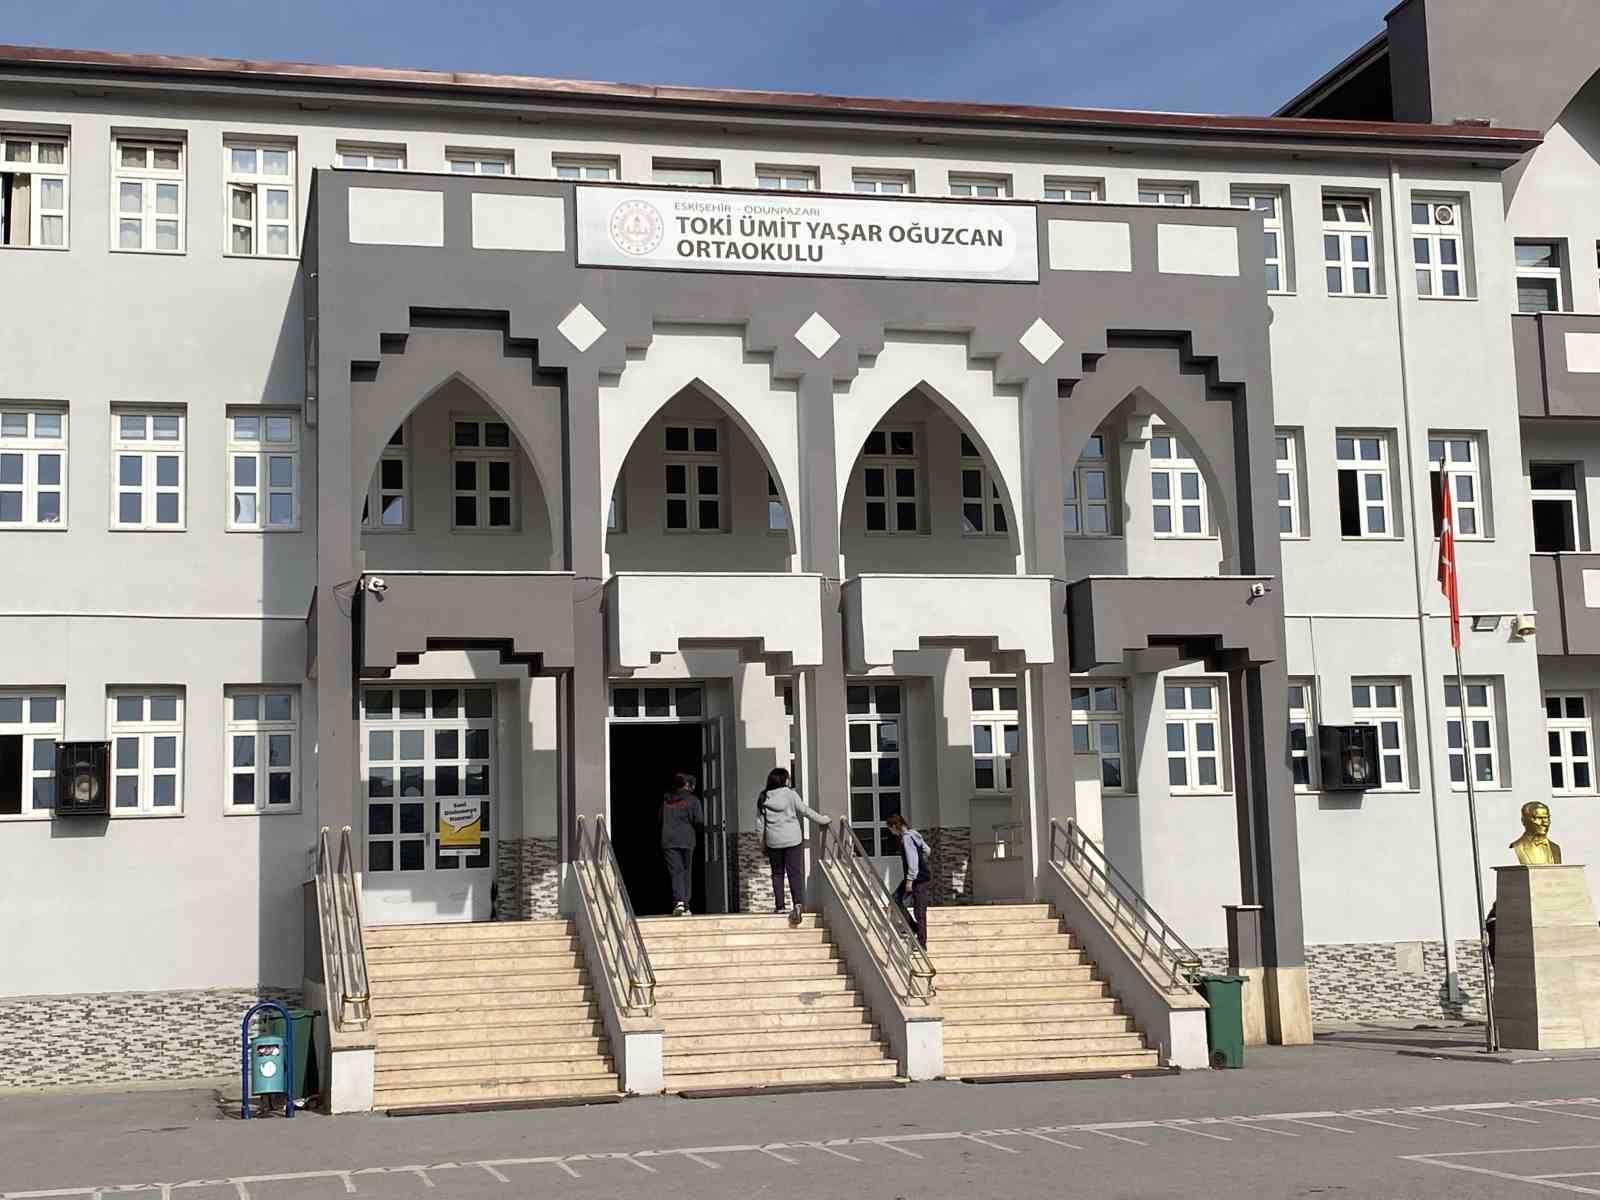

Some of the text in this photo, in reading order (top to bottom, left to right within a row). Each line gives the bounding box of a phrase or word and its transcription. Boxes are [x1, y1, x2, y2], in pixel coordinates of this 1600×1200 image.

[743, 204, 820, 217] ODUNPAZARI
[675, 214, 732, 236] TOKİ
[740, 215, 802, 239] ÜMİT
[806, 221, 883, 246] YAŞAR
[888, 222, 1003, 247] OĞUZCAN
[676, 239, 824, 263] ORTAOKULU
